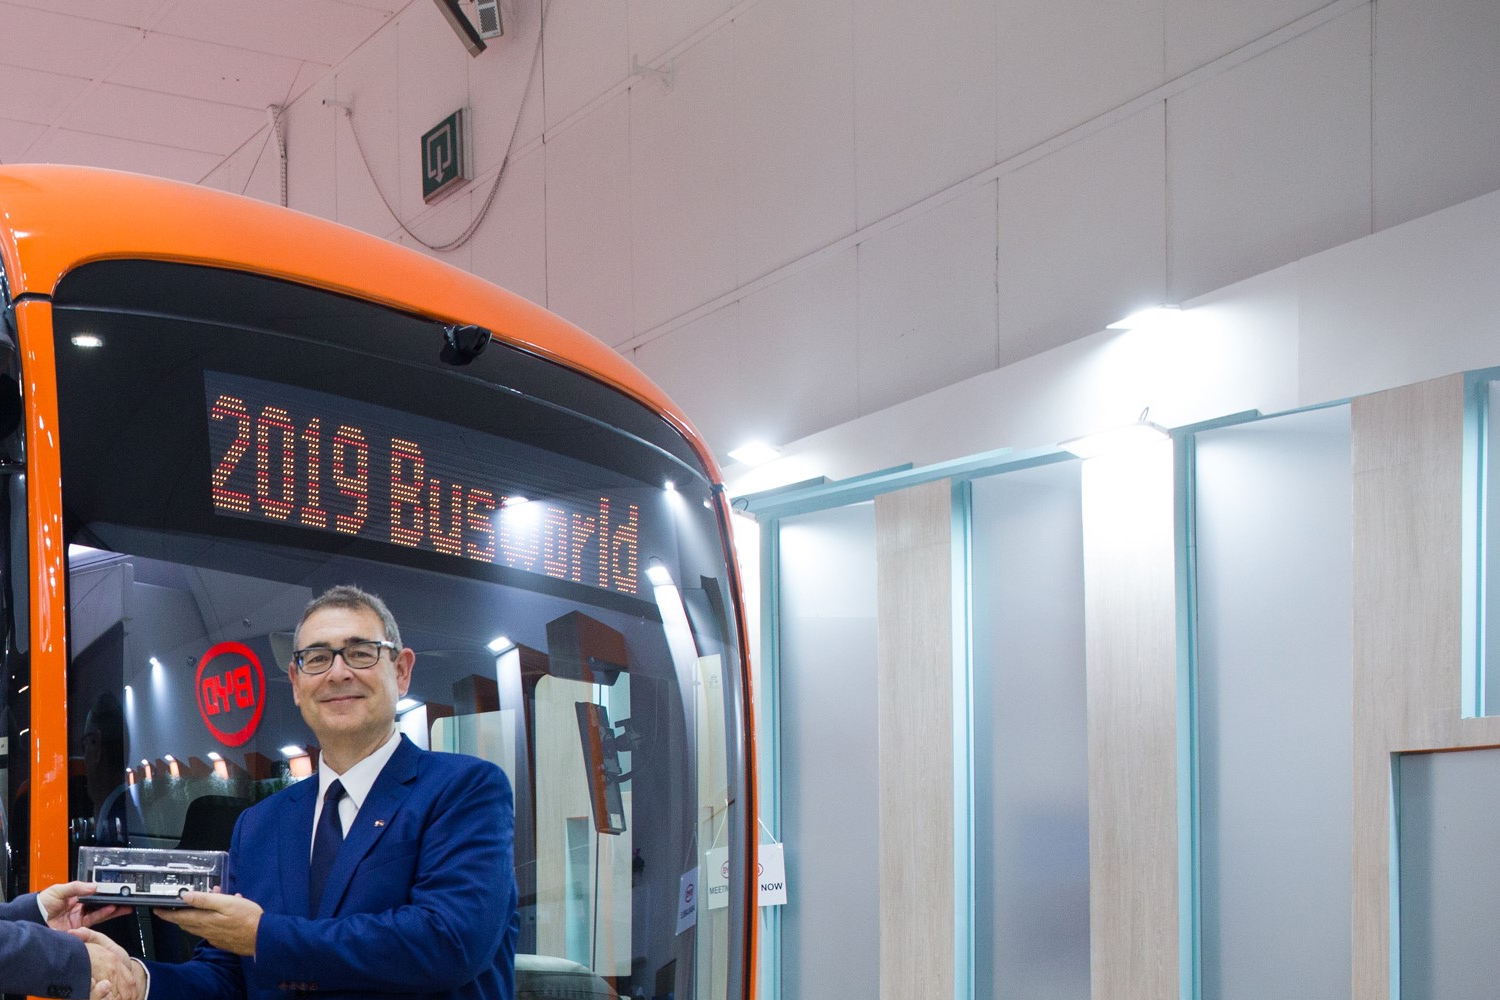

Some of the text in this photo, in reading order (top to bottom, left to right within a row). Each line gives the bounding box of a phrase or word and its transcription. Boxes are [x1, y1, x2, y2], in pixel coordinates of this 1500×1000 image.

[211, 394, 639, 595] 2019 Busworld
[761, 883, 783, 892] NOW
